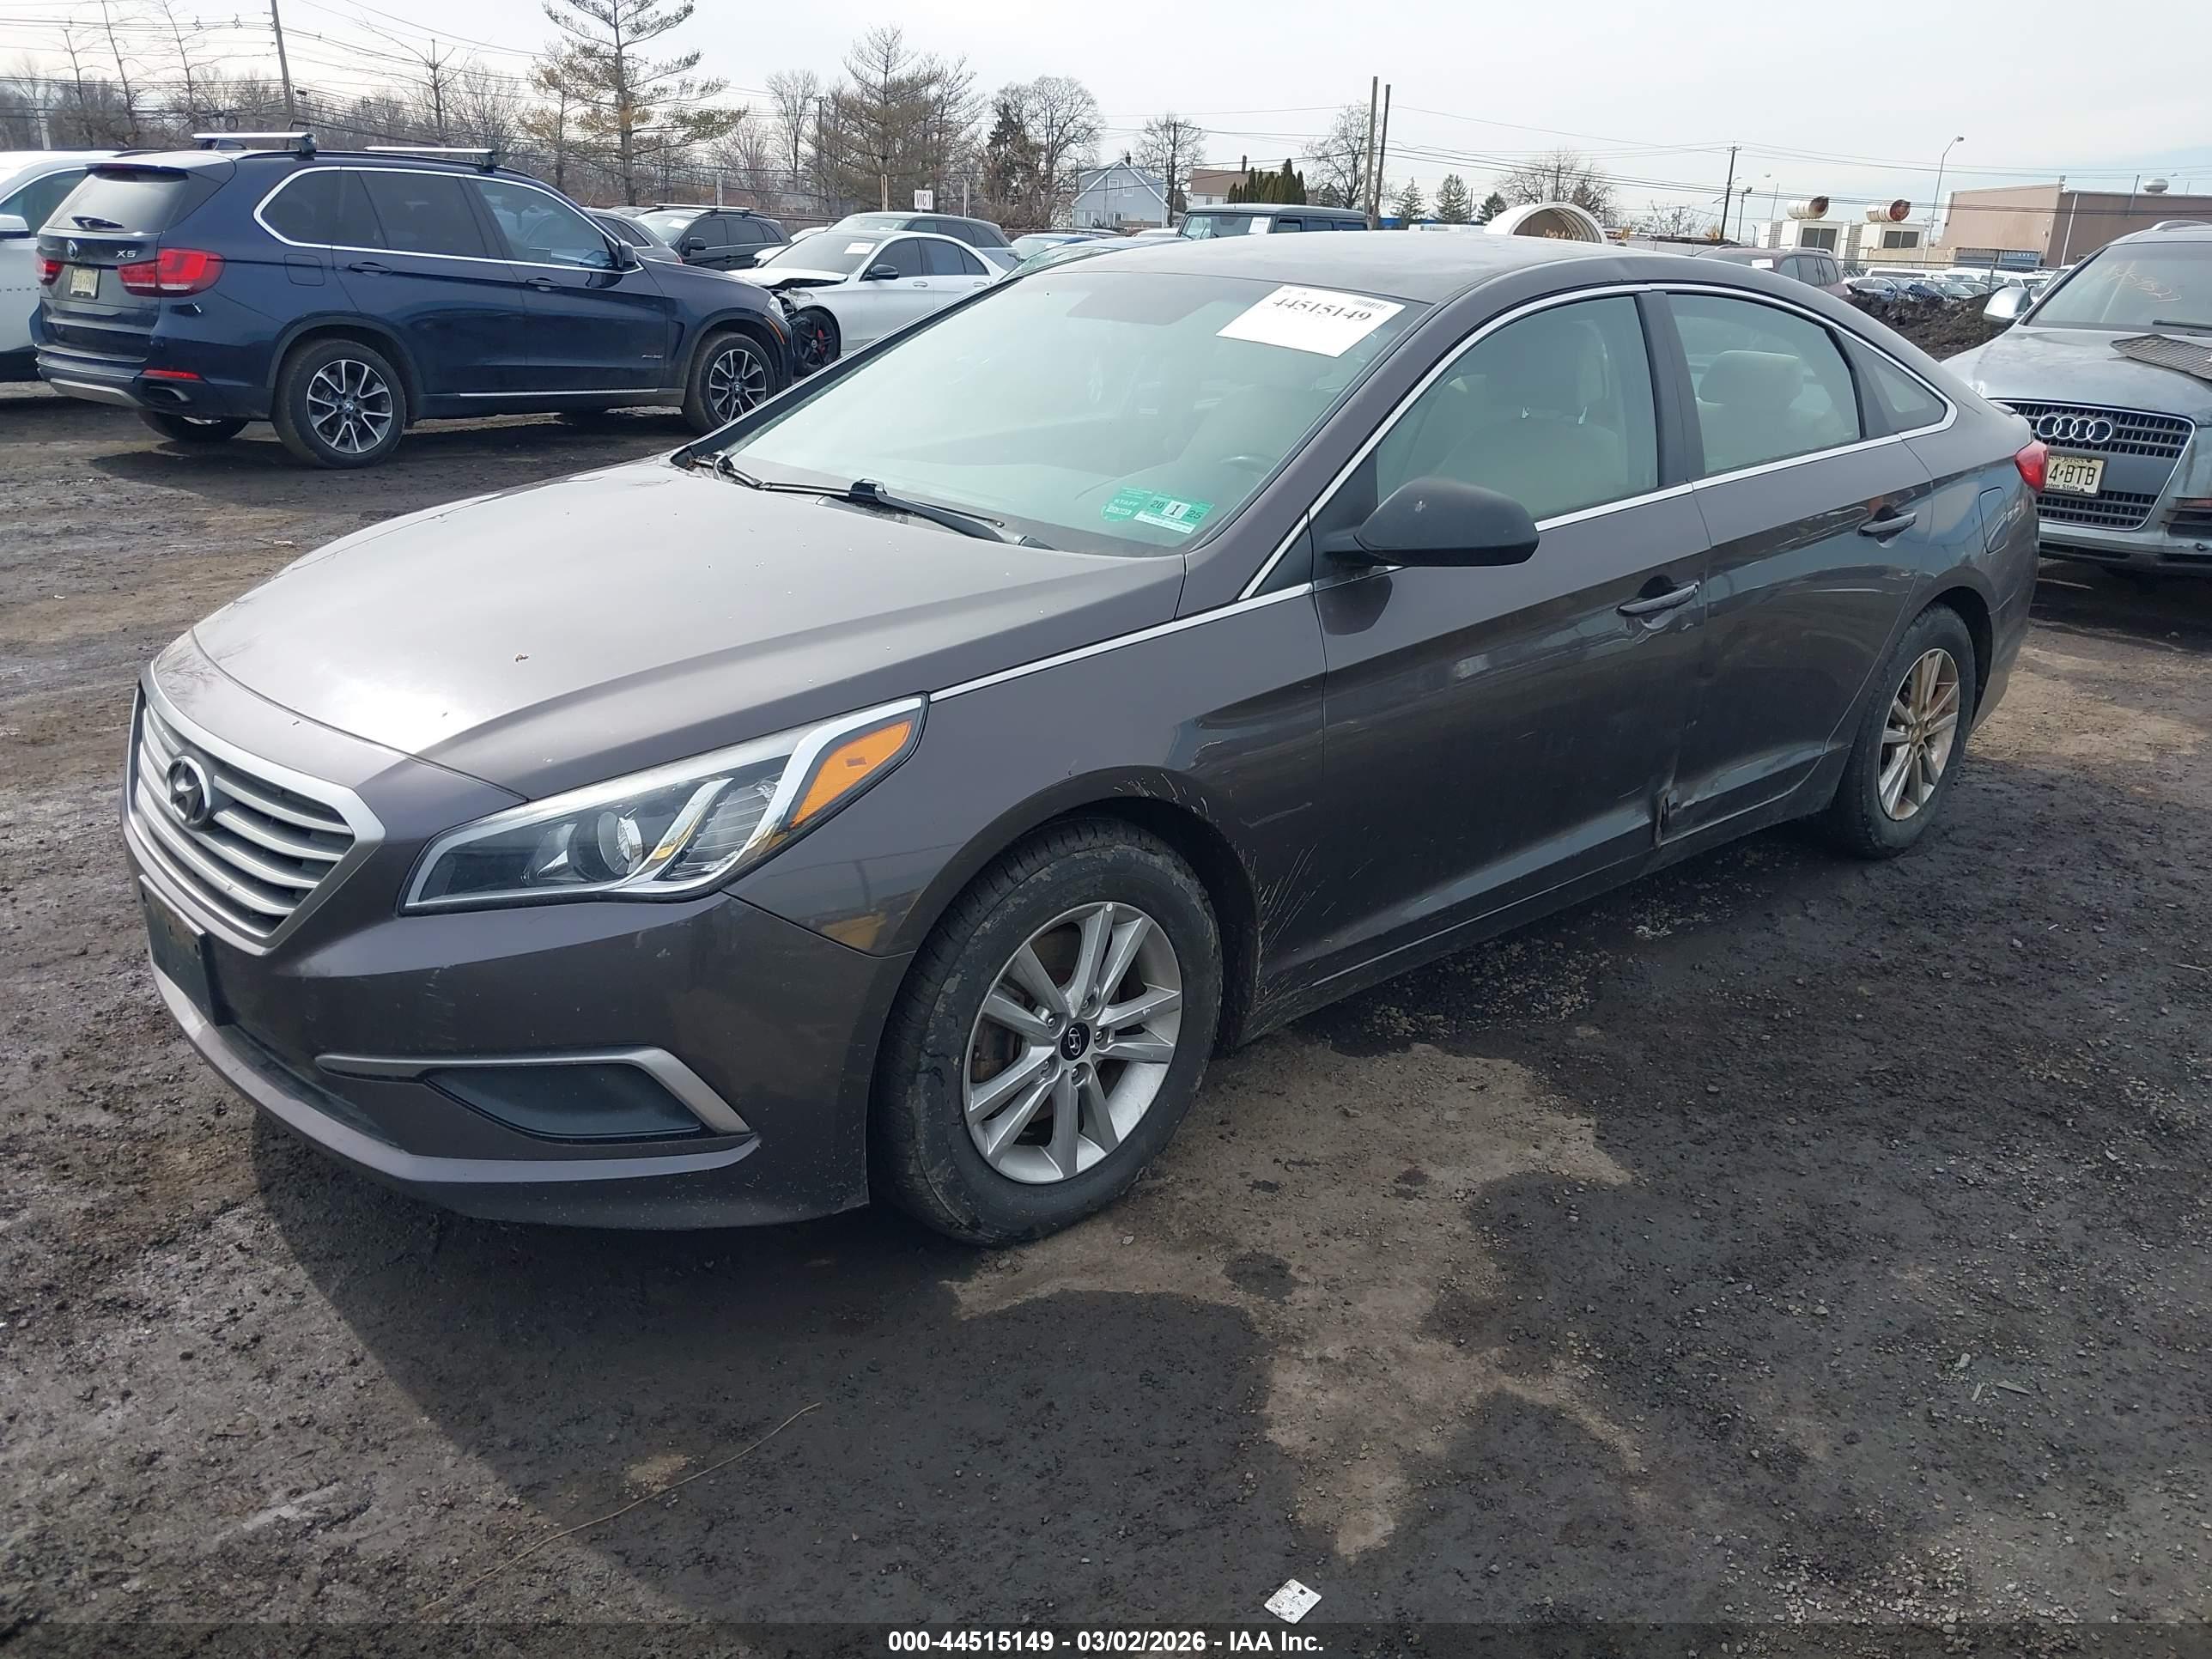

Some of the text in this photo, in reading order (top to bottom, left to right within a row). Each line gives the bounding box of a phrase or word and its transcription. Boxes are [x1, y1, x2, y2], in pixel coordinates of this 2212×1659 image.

[116, 250, 137, 258] X5
[1273, 297, 1372, 322] 44515149
[1151, 500, 1166, 509] 20
[1169, 504, 1182, 516] 1
[1187, 509, 1204, 520] 25
